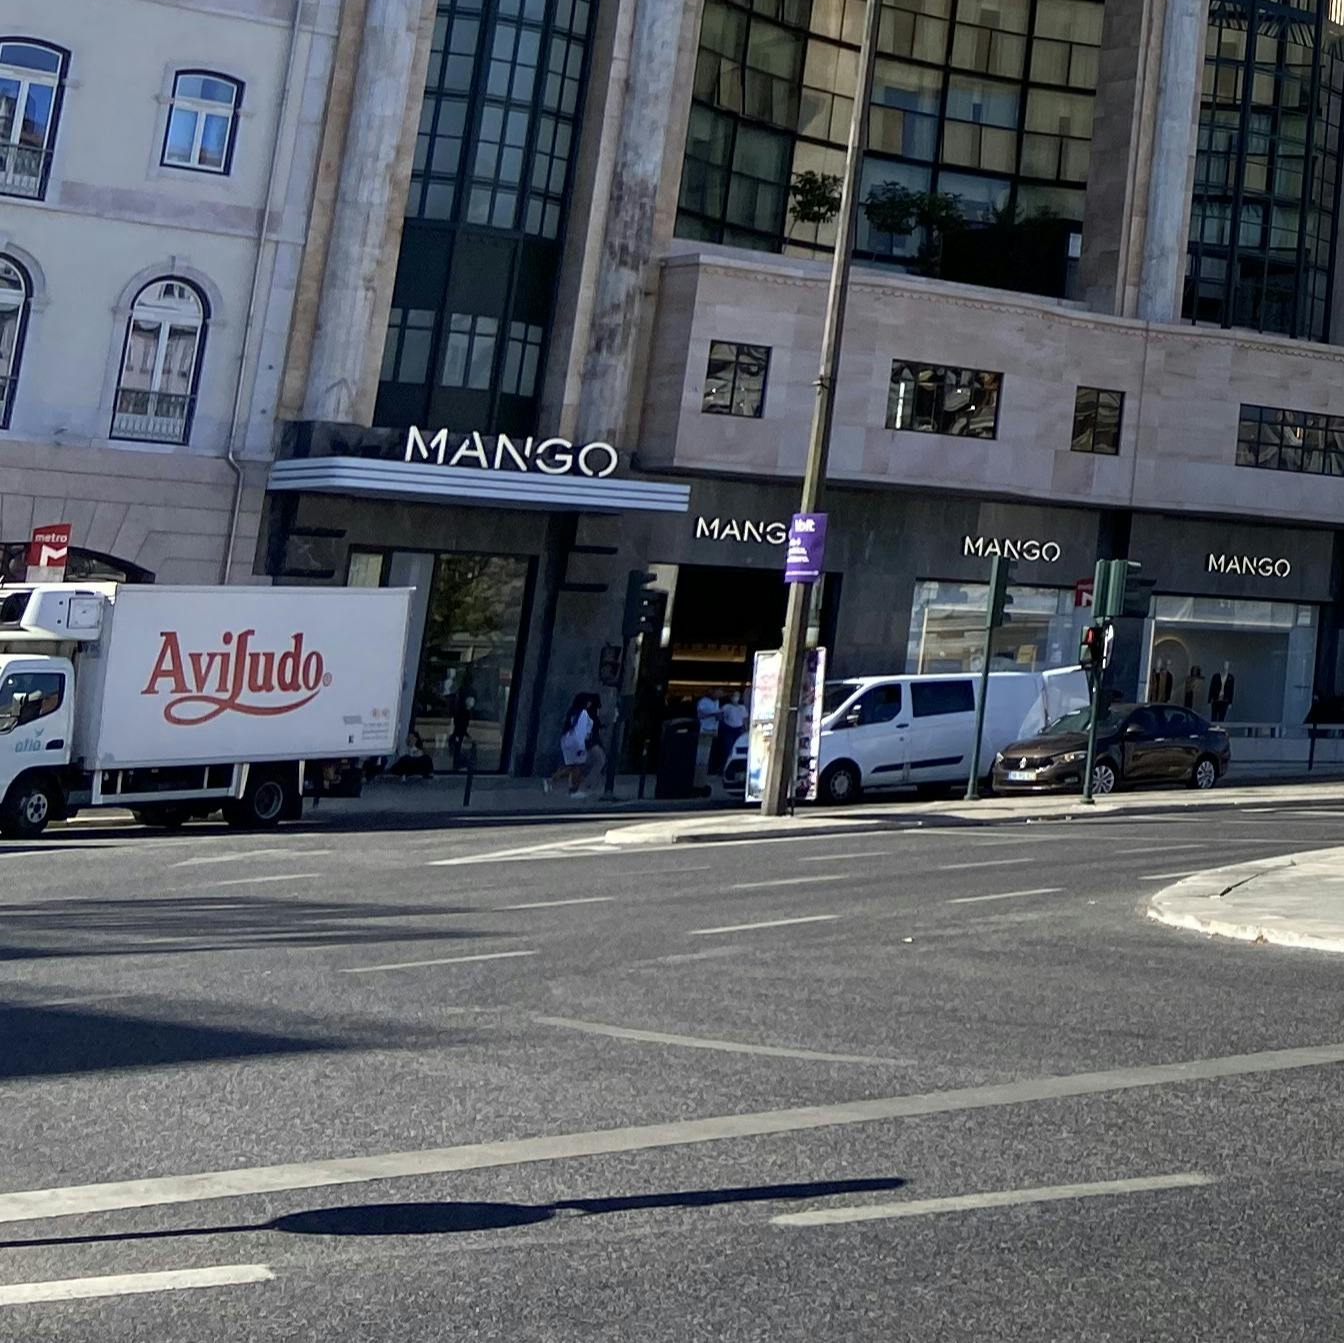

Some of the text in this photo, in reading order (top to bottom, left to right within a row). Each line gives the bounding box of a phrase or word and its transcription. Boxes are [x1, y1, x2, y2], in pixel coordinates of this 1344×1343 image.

[404, 424, 618, 478] MANGO
[34, 533, 68, 543] metro
[695, 516, 792, 545] MANG
[963, 535, 1061, 562] MANGO
[1207, 553, 1291, 578] MANGO
